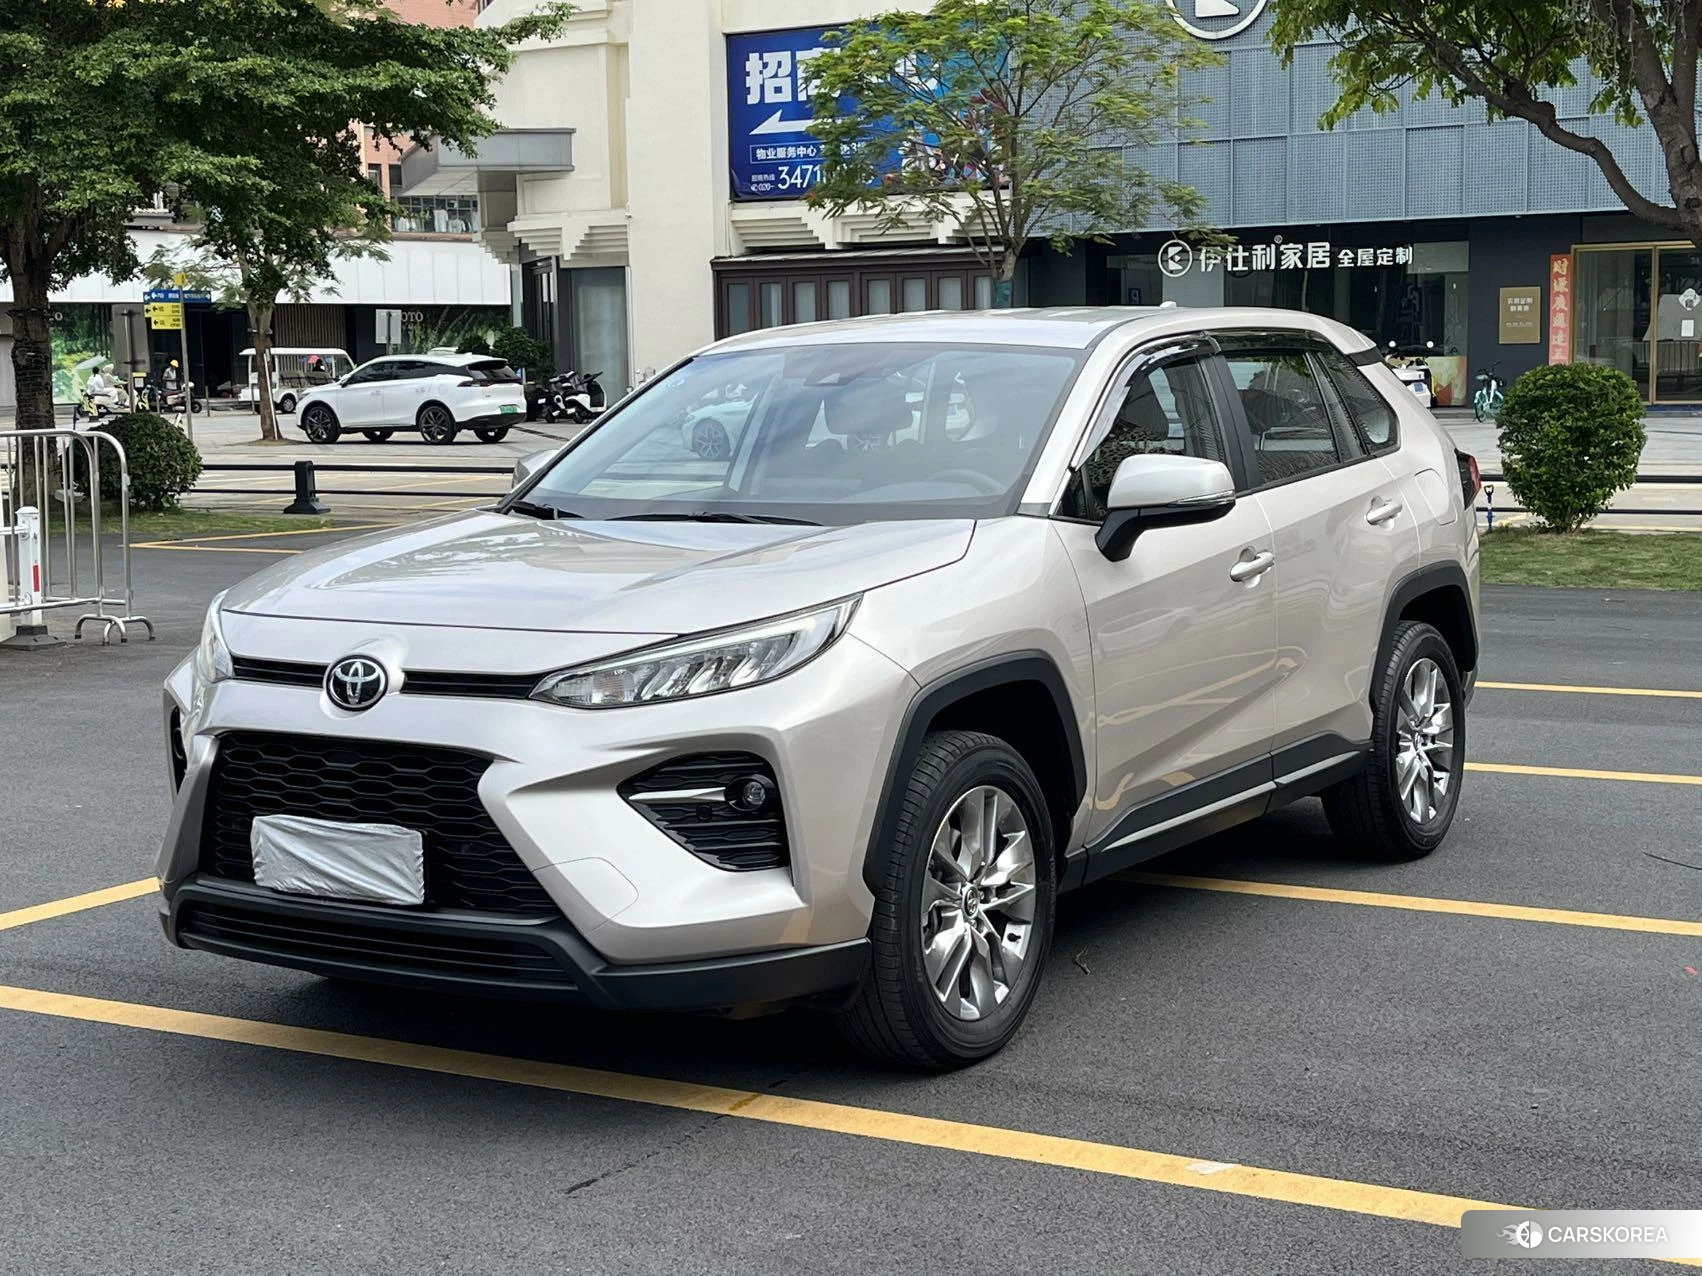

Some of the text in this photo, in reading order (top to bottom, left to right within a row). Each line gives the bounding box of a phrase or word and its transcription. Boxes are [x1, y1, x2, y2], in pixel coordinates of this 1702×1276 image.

[756, 145, 817, 160] 物业服务中心
[1200, 241, 1413, 272] 伊仕利家居 全屋定制
